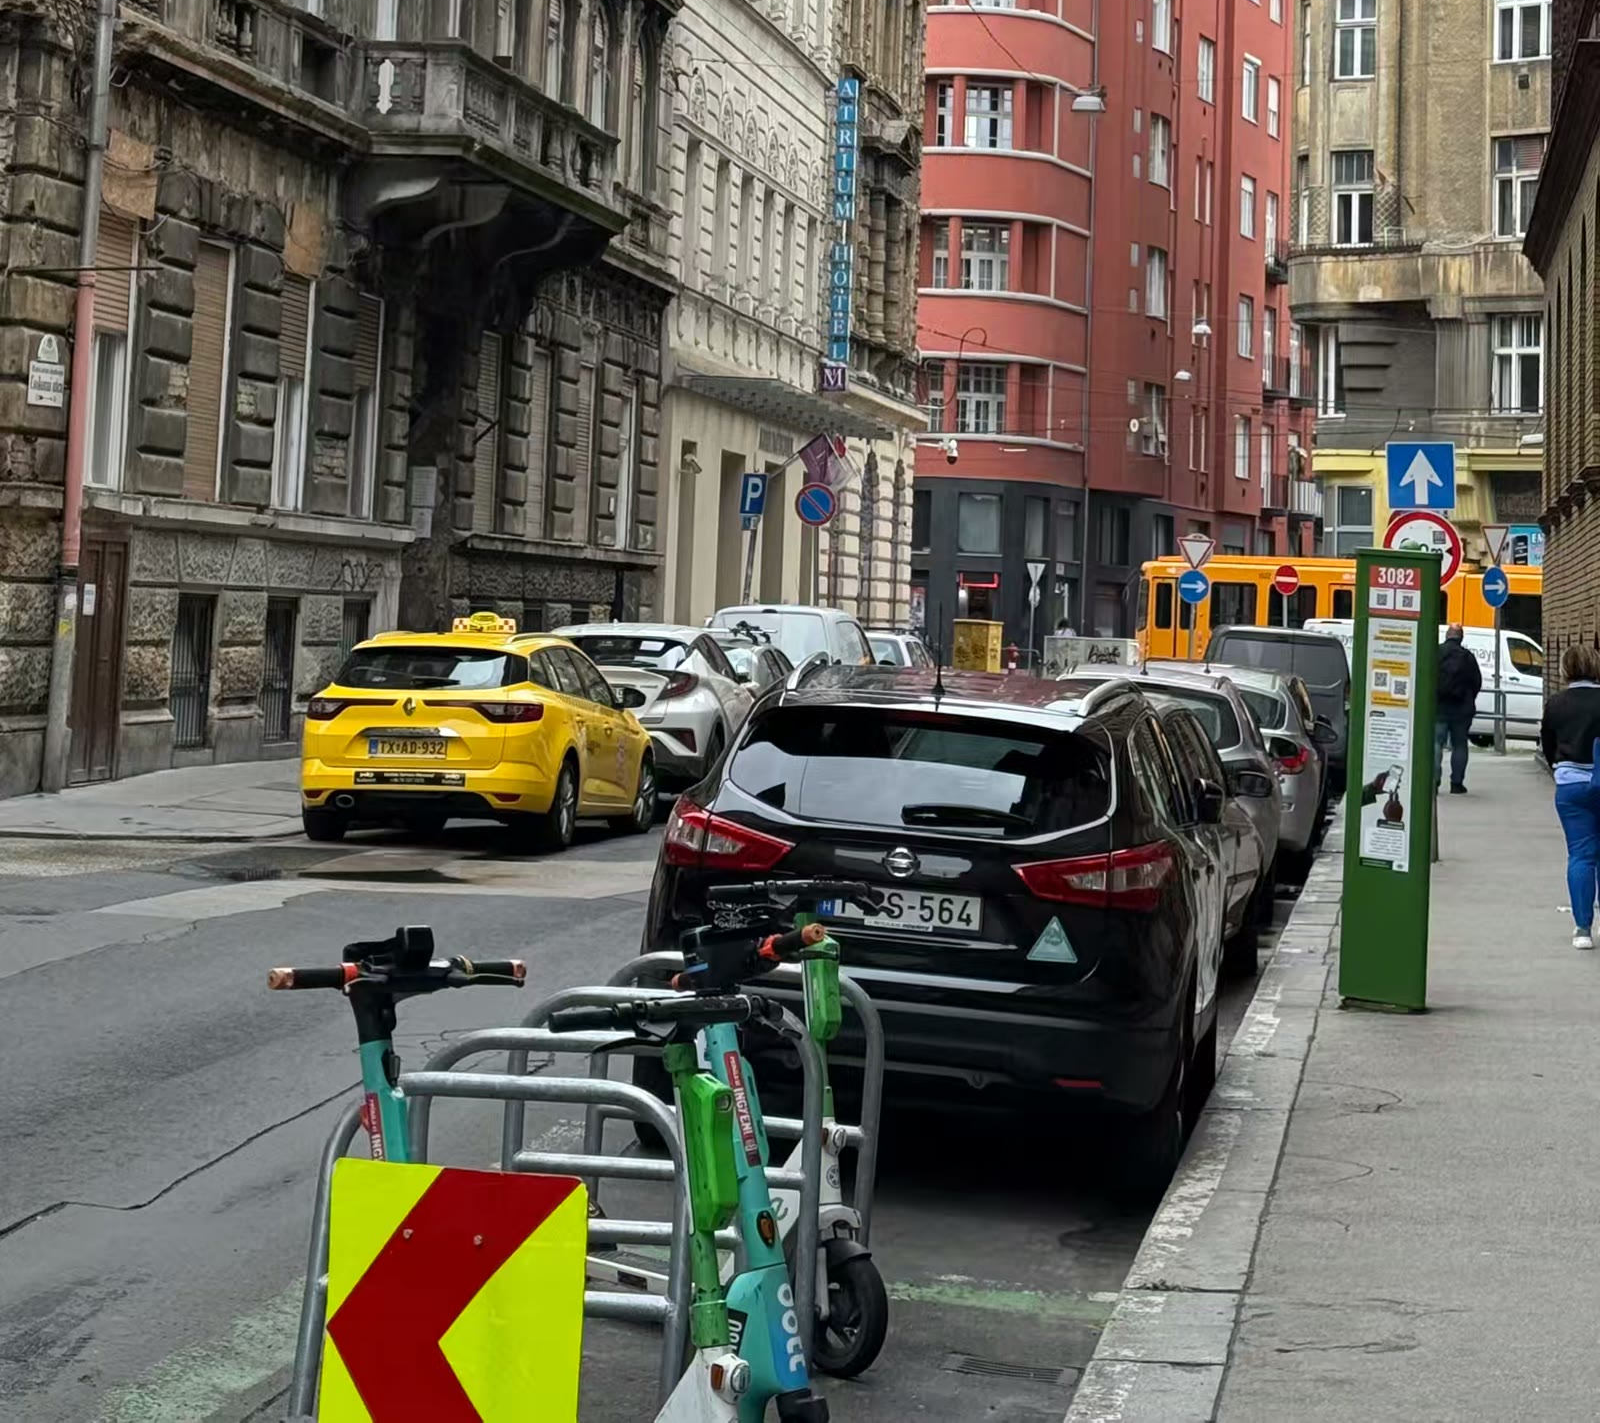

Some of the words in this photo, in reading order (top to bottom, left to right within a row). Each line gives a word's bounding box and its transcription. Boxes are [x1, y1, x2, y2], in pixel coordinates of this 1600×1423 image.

[835, 80, 854, 217] ATRIUM
[832, 245, 849, 359] HOTEL
[745, 477, 763, 511] P
[1378, 567, 1414, 586] 3082
